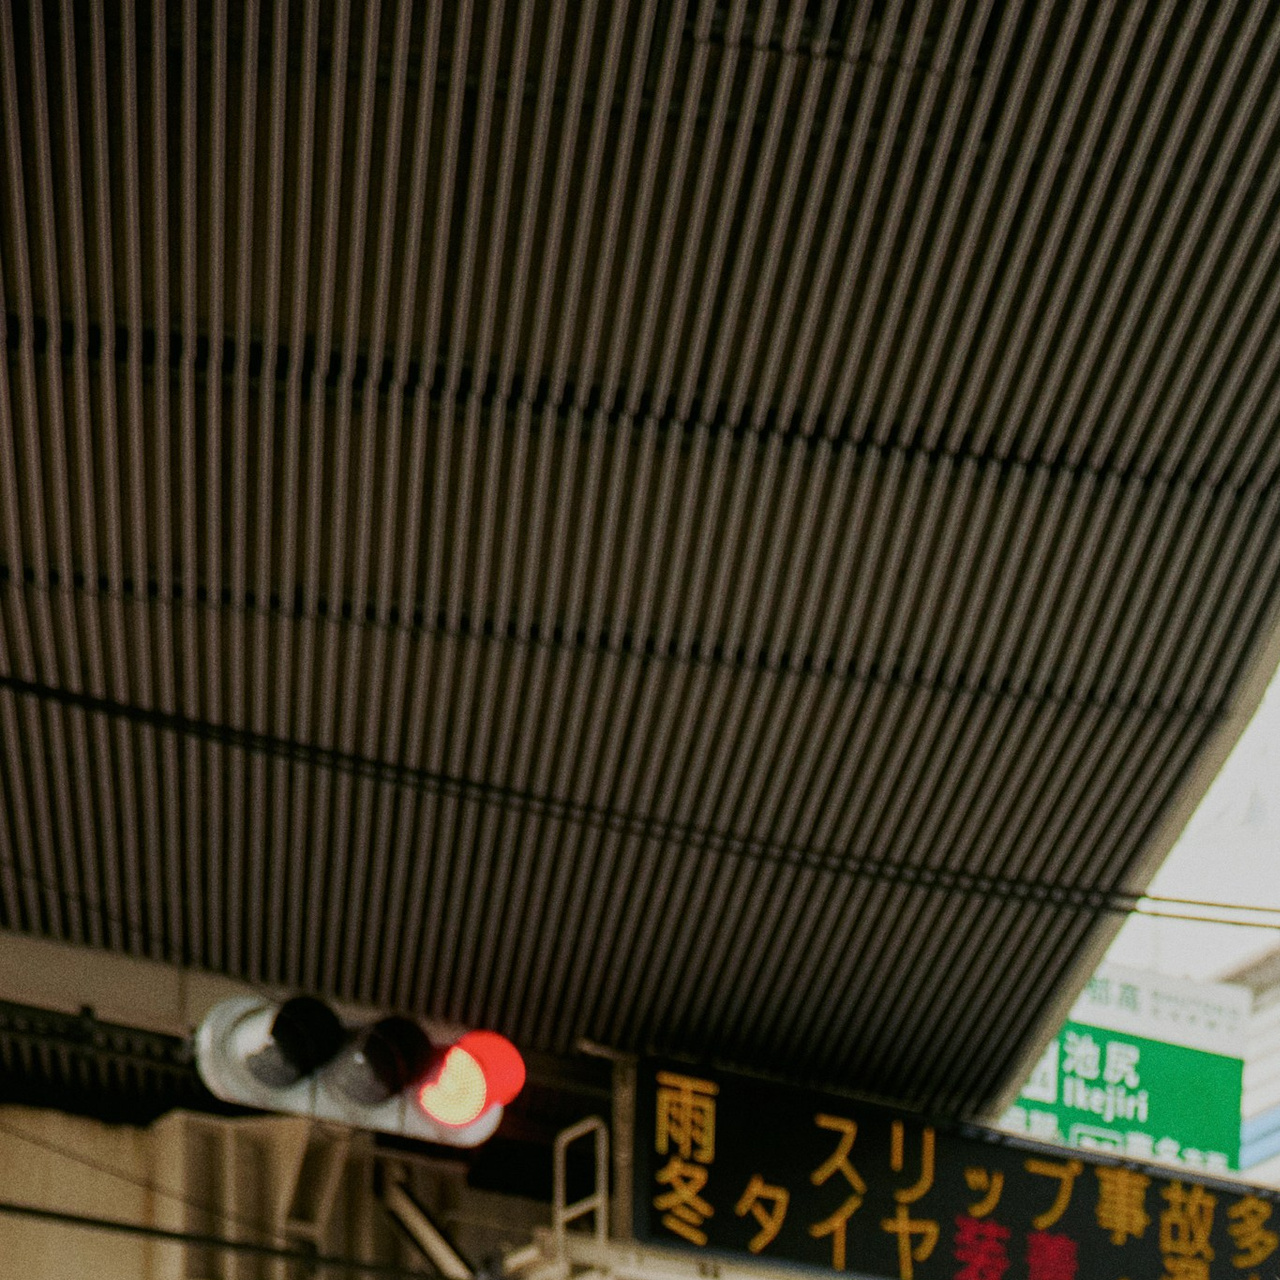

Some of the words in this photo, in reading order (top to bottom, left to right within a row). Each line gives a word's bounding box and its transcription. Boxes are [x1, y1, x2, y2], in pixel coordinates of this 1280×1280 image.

[1062, 1030, 1141, 1090] 池尻
[654, 1070, 720, 1164] 雨
[1062, 1074, 1149, 1123] Ikejiri
